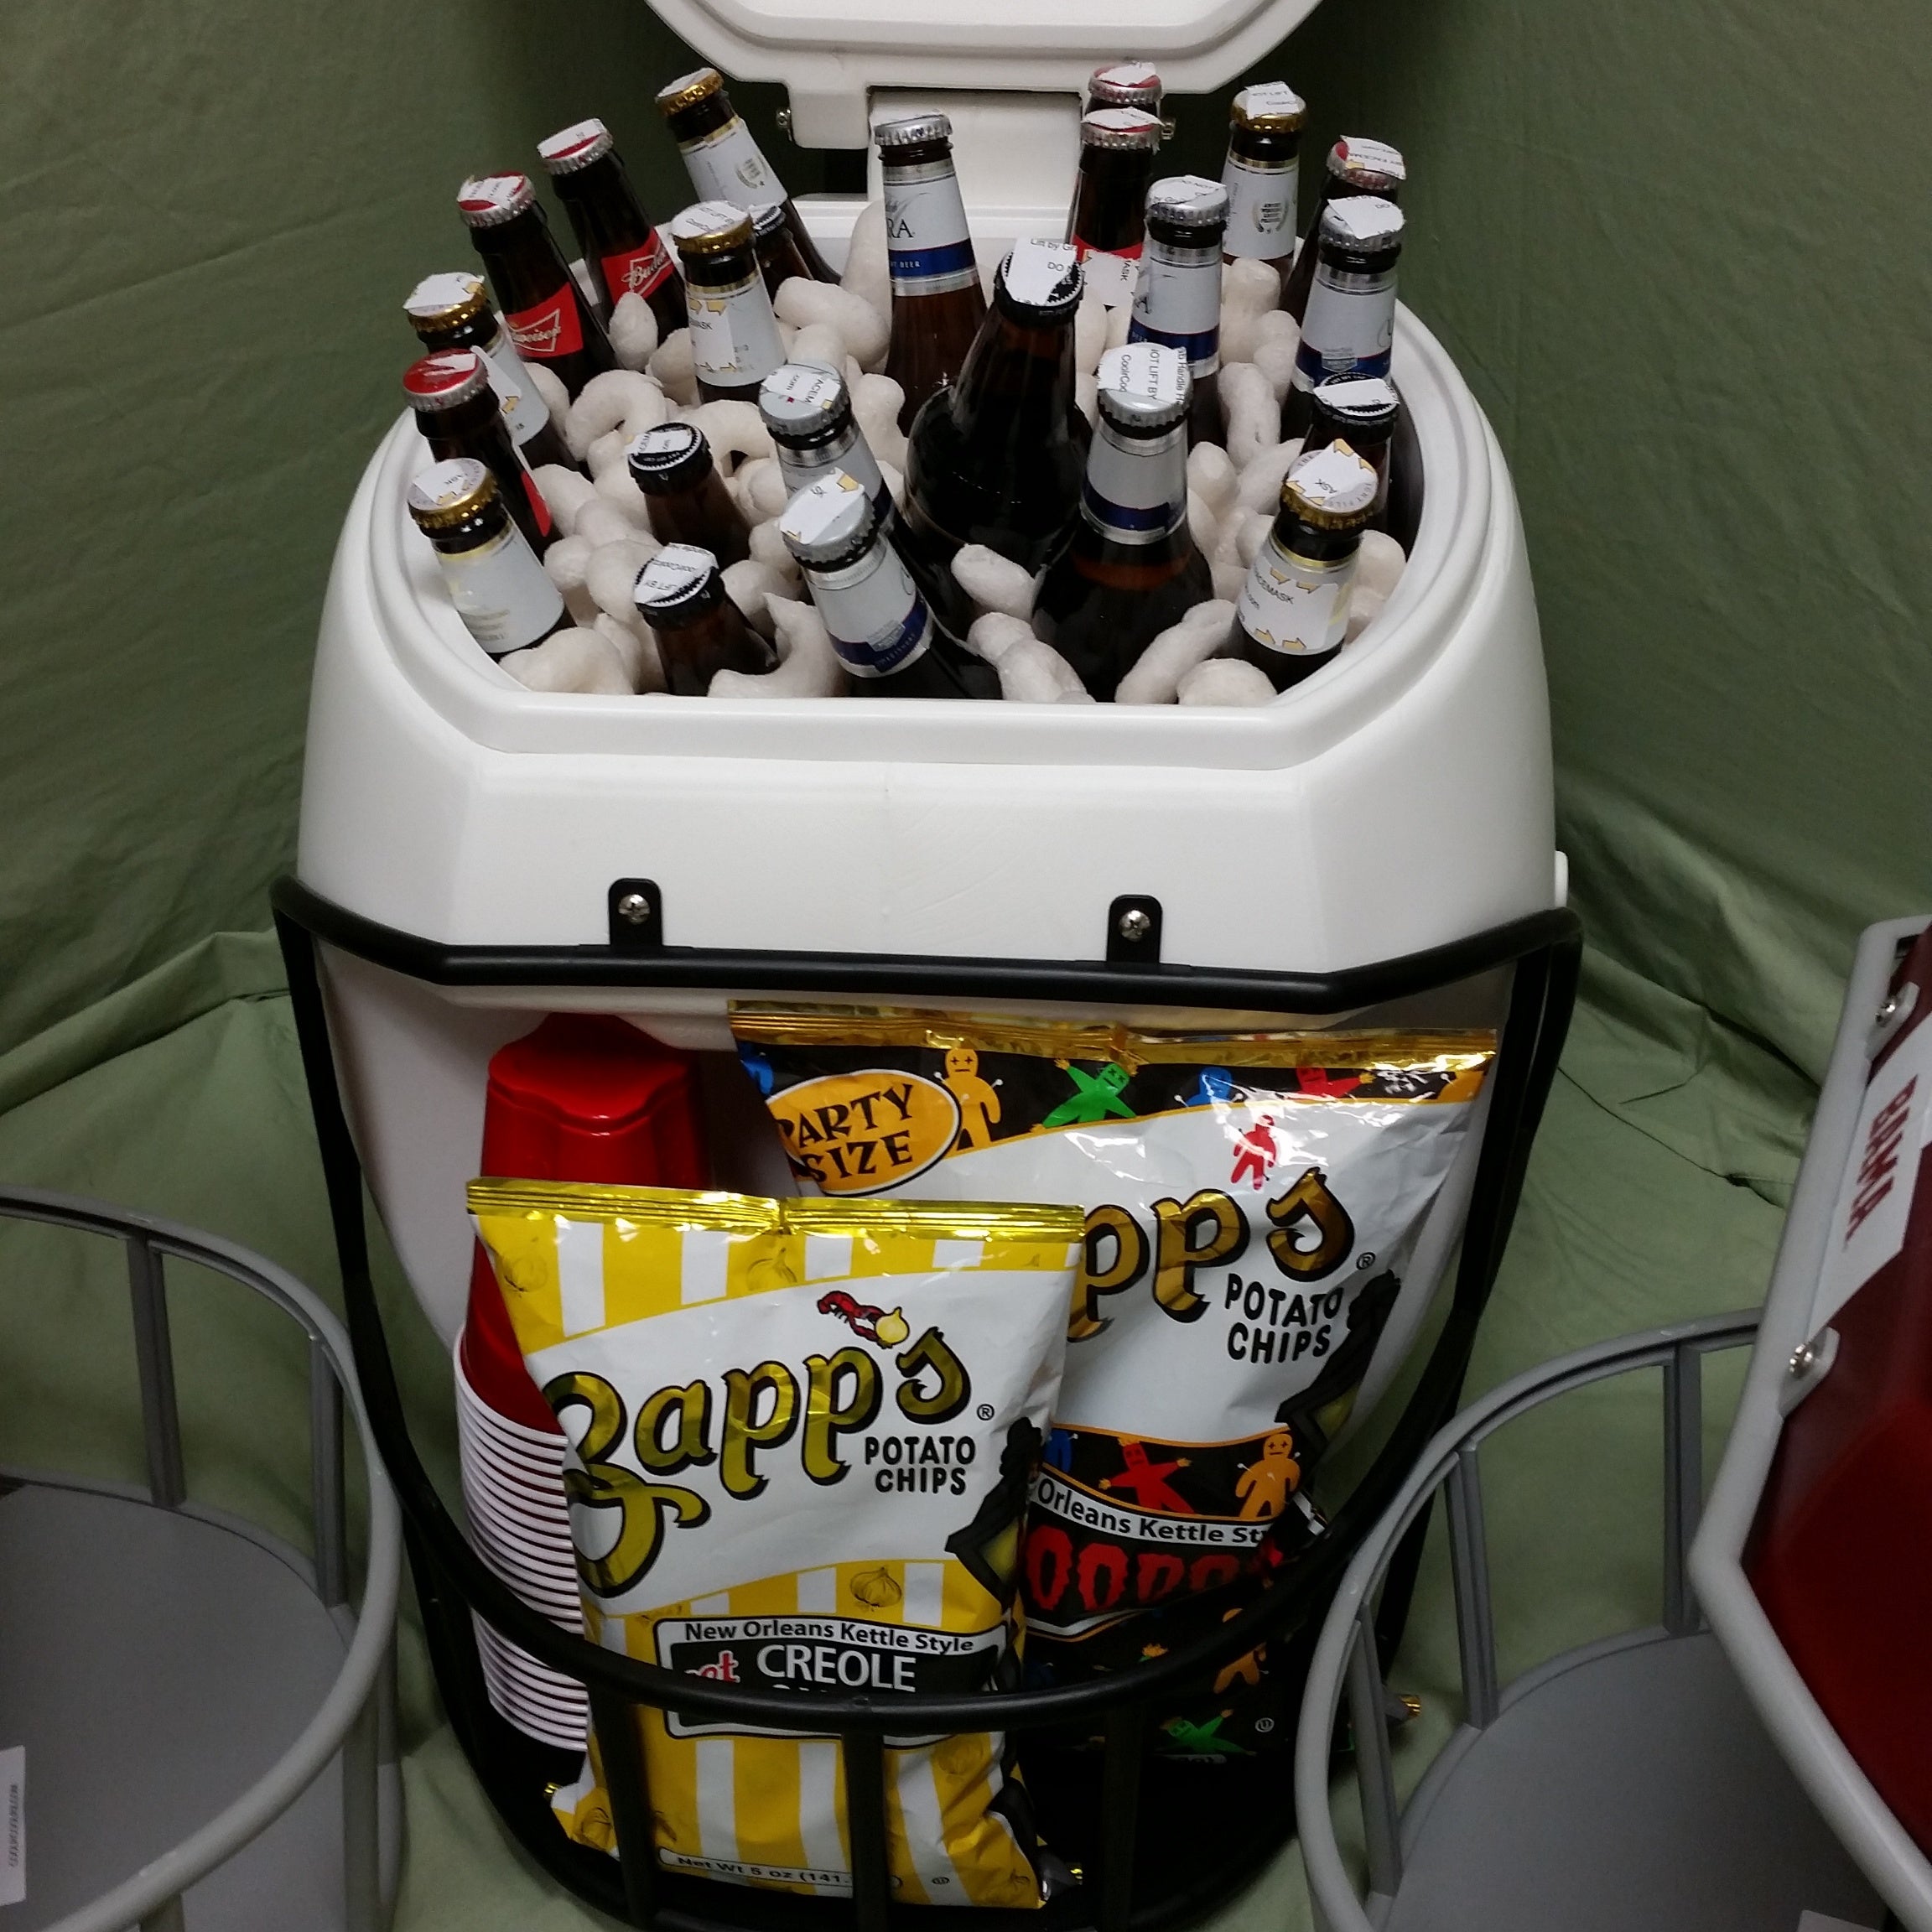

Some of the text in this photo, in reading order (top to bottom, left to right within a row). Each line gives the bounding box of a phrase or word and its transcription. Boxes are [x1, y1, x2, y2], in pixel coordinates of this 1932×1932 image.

[1047, 261, 1064, 272] DO
[1149, 366, 1159, 383] LIFT
[1176, 362, 1186, 391] Handle
[1147, 386, 1158, 401] BY
[775, 1083, 914, 1149] PARTY
[801, 1130, 913, 1183] SIZE
[1224, 1273, 1345, 1327] POTATO
[1227, 1322, 1332, 1364] CHIPS
[865, 1436, 976, 1465] POTATO
[875, 1467, 967, 1496] CHIPS
[1037, 1478, 1131, 1535] Orleans
[1140, 1517, 1224, 1543] Kettle
[685, 1619, 974, 1656] New Orleans Kettle Style
[756, 1644, 917, 1693] CREOLE
[678, 1857, 712, 1869] Net
[716, 1862, 743, 1874] Wt
[750, 1867, 761, 1877] 5
[769, 1870, 792, 1879] oz
